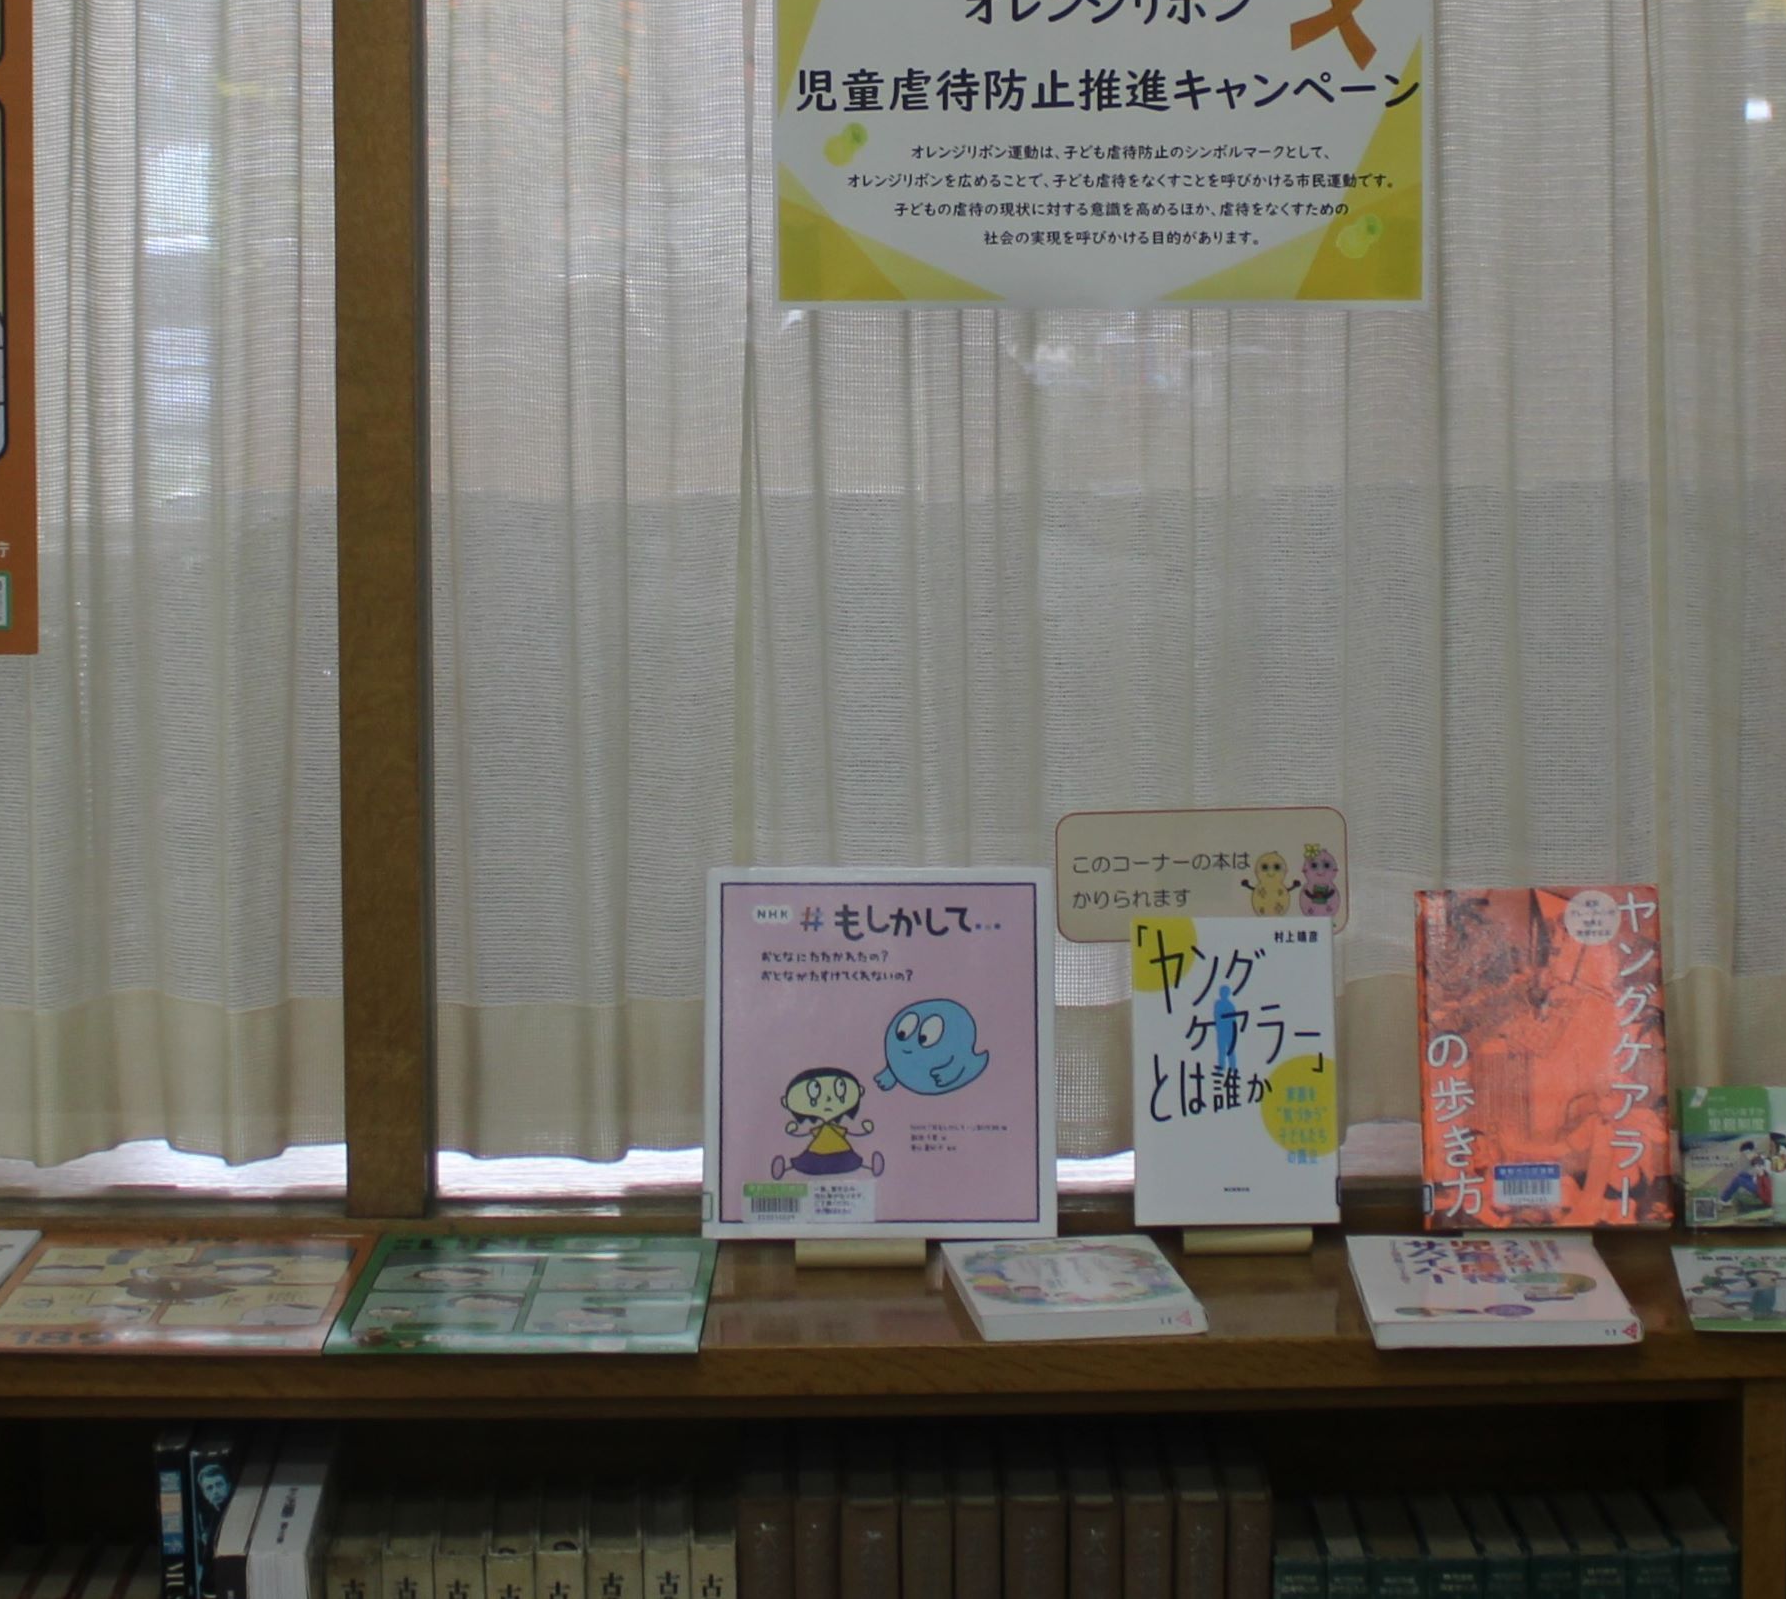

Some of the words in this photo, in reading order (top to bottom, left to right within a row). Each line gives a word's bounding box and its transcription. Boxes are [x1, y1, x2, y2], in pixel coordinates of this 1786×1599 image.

[795, 67, 1420, 113] 児童虐待防止推進キャンペーン
[909, 144, 1331, 162] オレンジリボン運動は、子ども虐待防止のシンボルマークとして、
[846, 172, 1394, 190] オレンジリボンを広めることで、子ども虐待をなくすことを呼びかける市民運動です。
[893, 201, 1349, 218] 子どもの虐待の現状に対する意識を高めるほか、虐待をなくすための
[983, 230, 1263, 247] 社会の実現を呼びかける目的があります。
[1072, 851, 1252, 875] このコーナーの本は
[1071, 888, 1192, 910] かりられます
[756, 908, 790, 920] NHK
[1610, 891, 1658, 1218] ヤングケアラー
[1149, 1052, 1273, 1123] とは誰か
[1426, 1032, 1484, 1218] の歩き方
